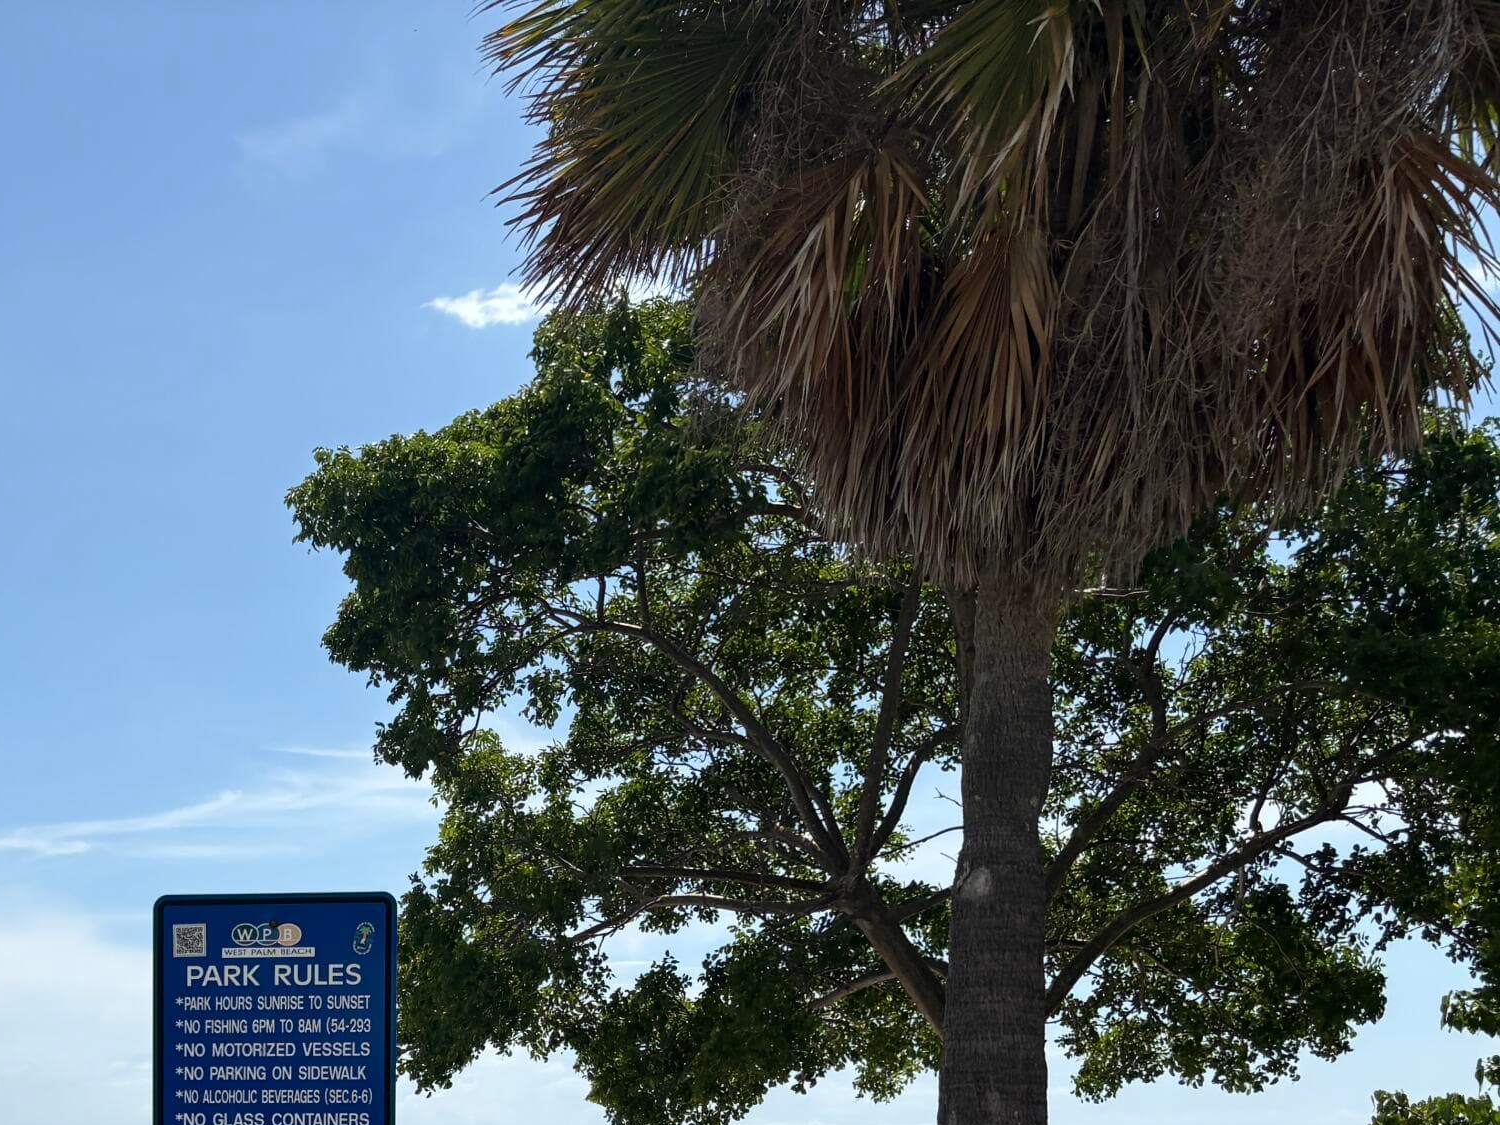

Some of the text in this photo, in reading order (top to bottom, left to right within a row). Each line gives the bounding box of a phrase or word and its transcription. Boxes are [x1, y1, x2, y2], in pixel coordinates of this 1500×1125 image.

[187, 964, 361, 987] PARK RULES
[216, 996, 252, 1010] HOURS
[257, 996, 304, 1010] SUNRISE
[309, 995, 322, 1009] TO
[327, 995, 371, 1009] SUNSET
[205, 1020, 247, 1034] FISHING
[252, 1019, 275, 1033] 6PM
[280, 1019, 293, 1033] TO
[298, 1019, 321, 1032] 8AM
[326, 1018, 371, 1035] (54-293
[212, 1043, 296, 1057] MOTORIZED
[302, 1042, 370, 1056] VESSELS
[210, 1066, 266, 1080] PARKING
[272, 1066, 292, 1080] ON
[298, 1066, 366, 1080] SIDEWALK
[203, 1090, 257, 1103] ALCOHOLIC
[262, 1089, 320, 1103] BEVERAGES
[324, 1089, 372, 1105] (SEC.6-6)
[272, 1113, 370, 1125] CONTAINERS
